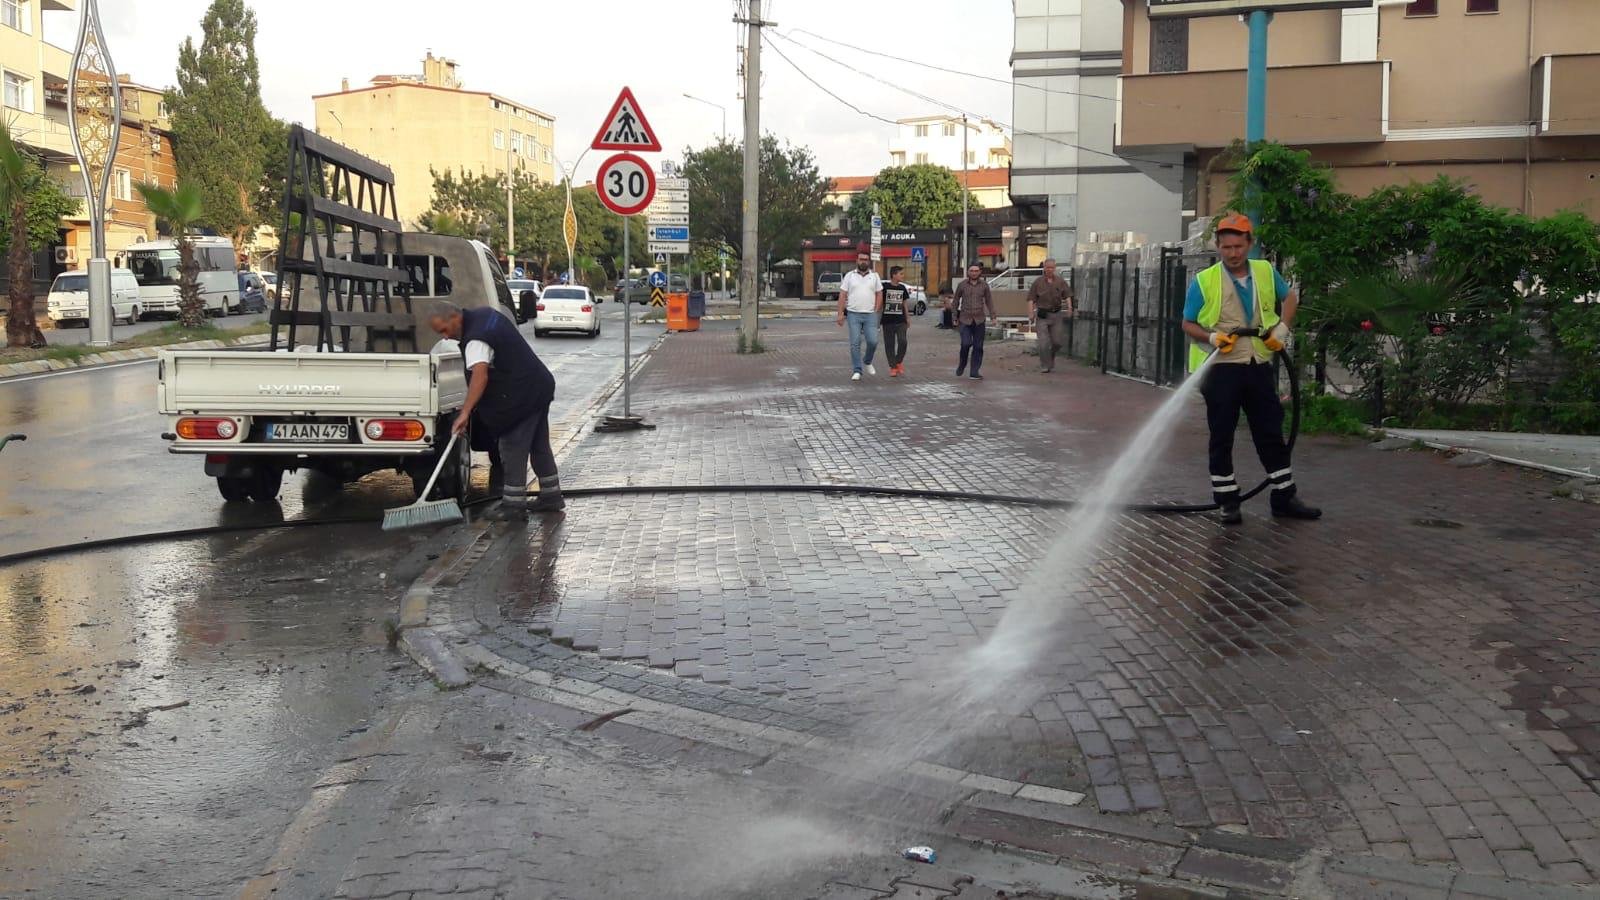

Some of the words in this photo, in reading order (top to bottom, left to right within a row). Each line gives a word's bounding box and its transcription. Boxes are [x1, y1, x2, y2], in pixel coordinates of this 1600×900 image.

[608, 170, 645, 197] 30
[258, 384, 341, 395] HYUNDAI
[273, 425, 287, 438] 41
[289, 425, 320, 438] AAN
[322, 425, 347, 438] 479
